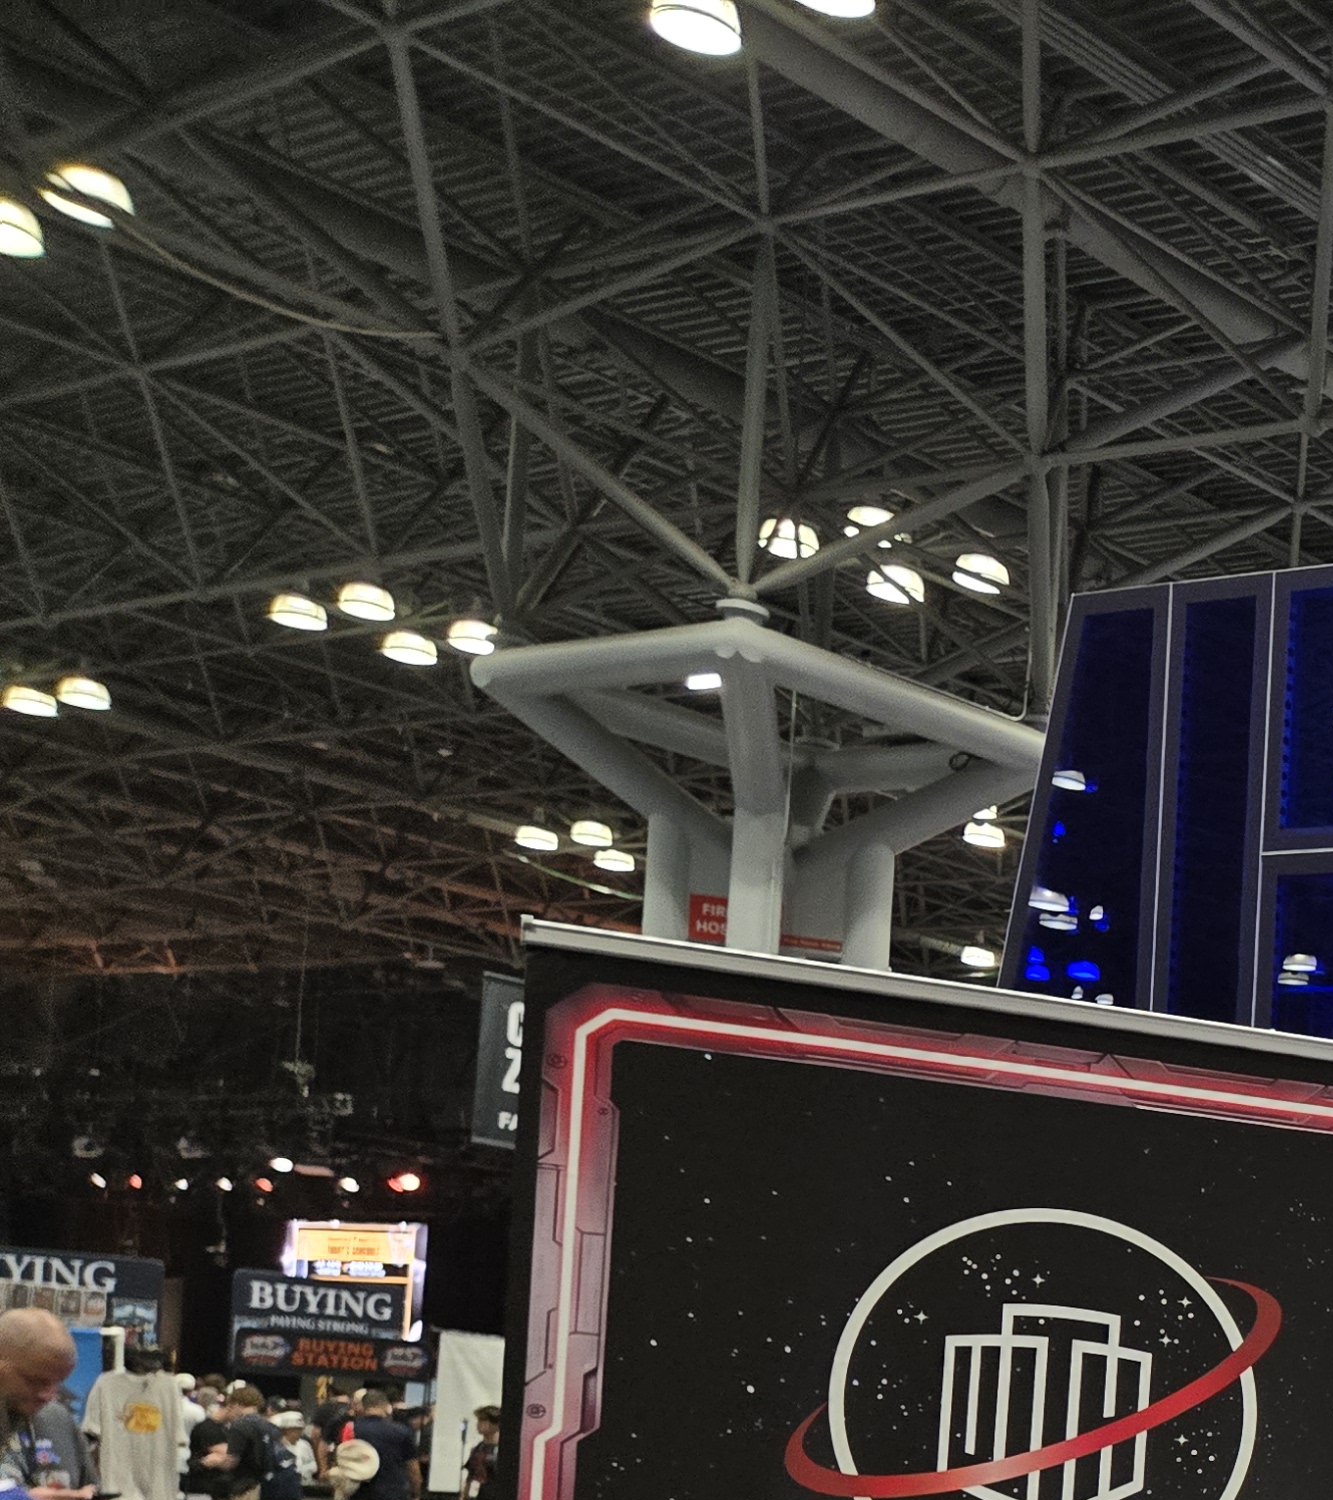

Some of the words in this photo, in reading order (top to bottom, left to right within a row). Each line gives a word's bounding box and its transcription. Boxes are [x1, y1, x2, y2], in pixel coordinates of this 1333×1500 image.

[250, 1279, 393, 1322] BUYING
[297, 1337, 374, 1355] BUYING
[290, 1350, 378, 1371] STATION
